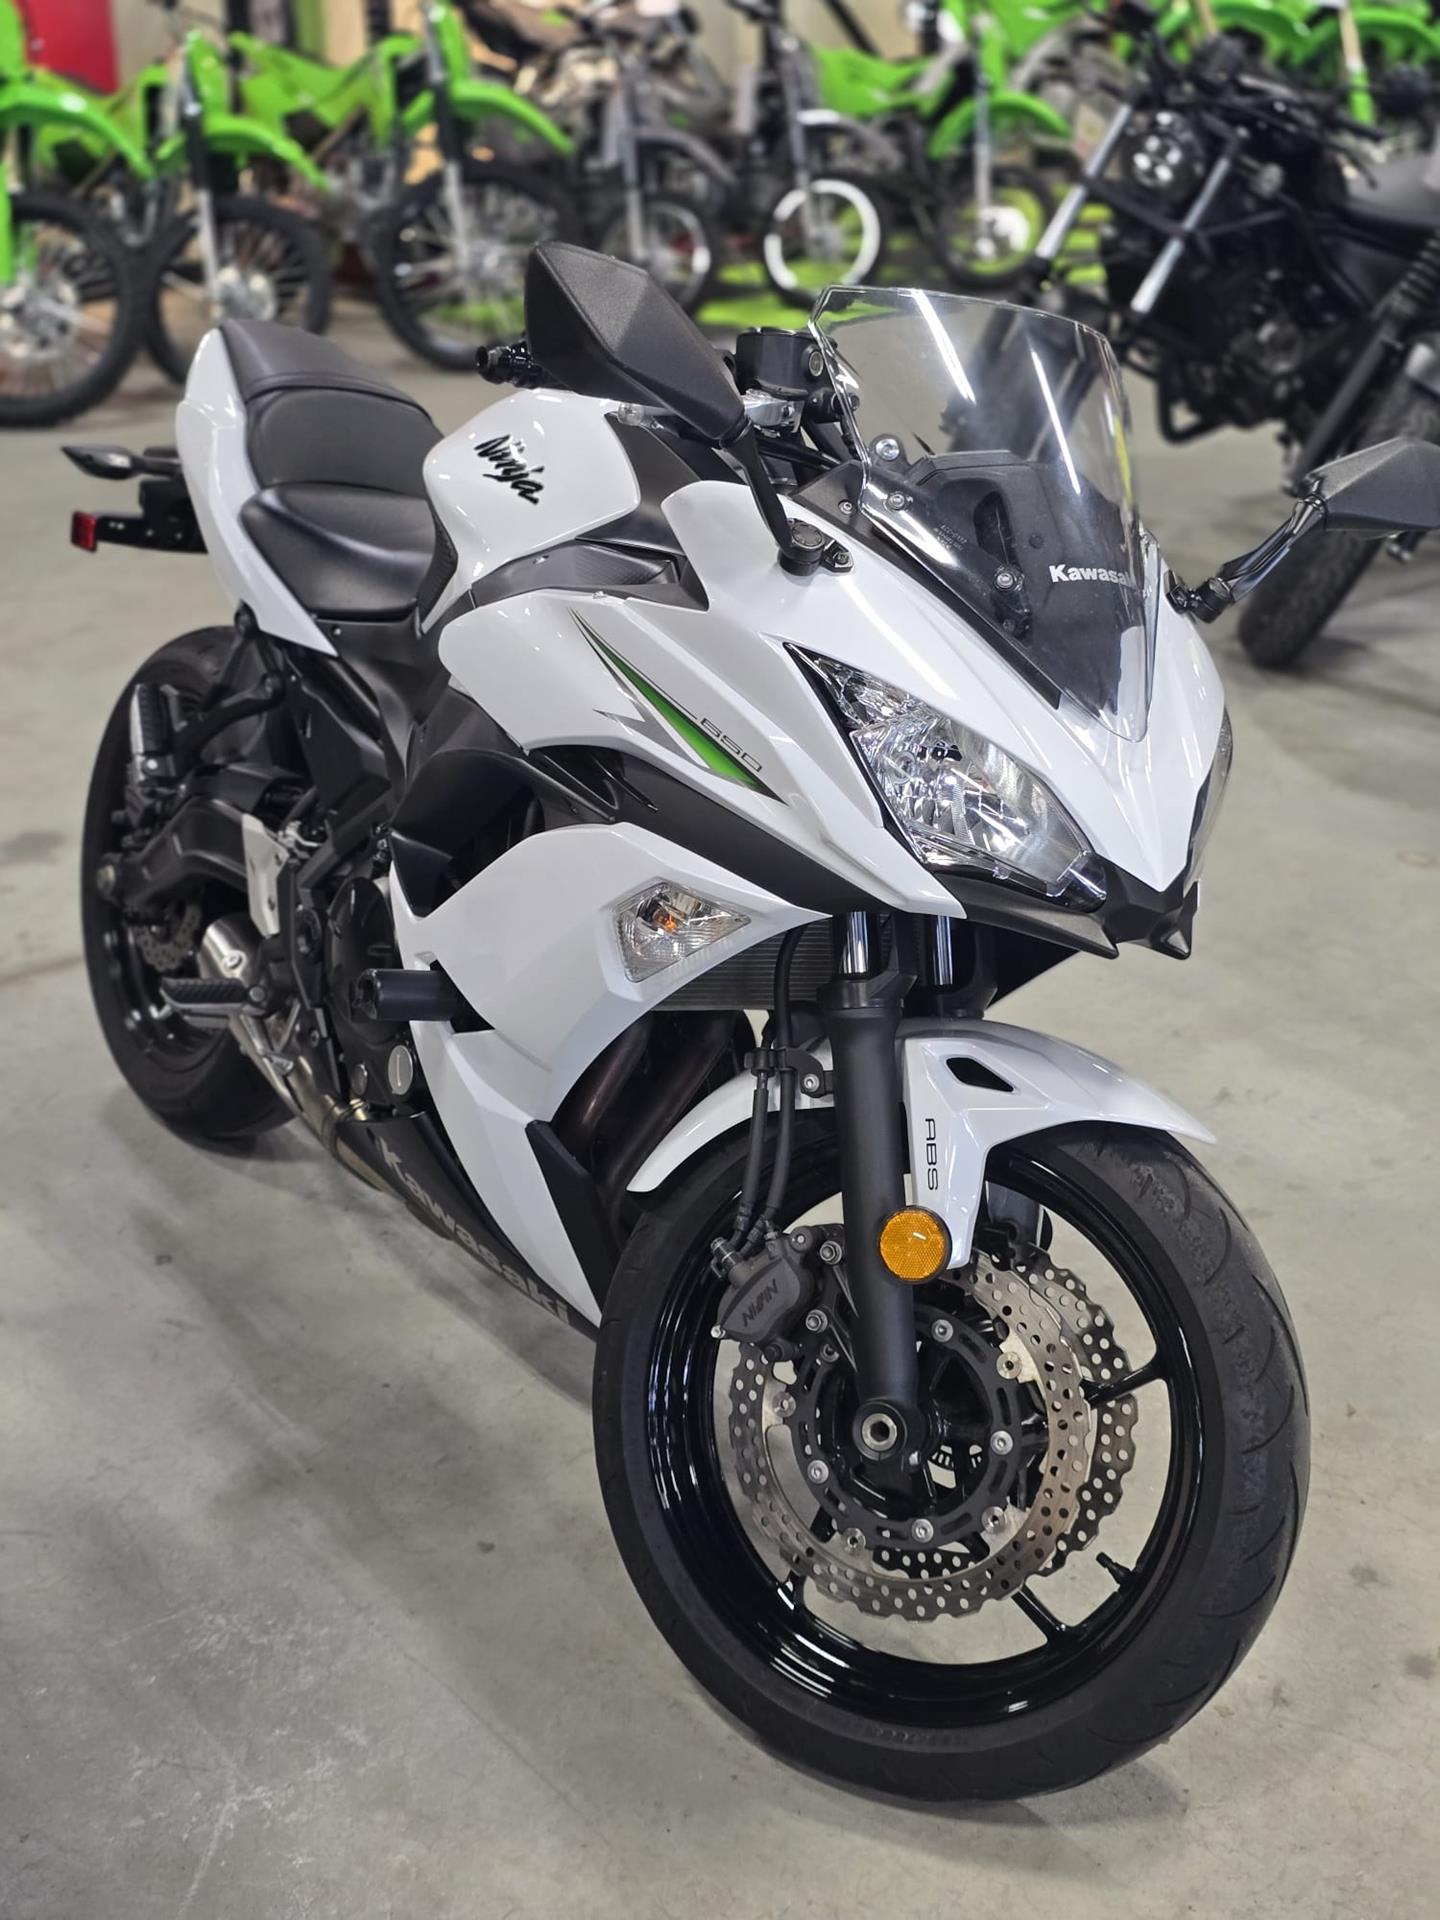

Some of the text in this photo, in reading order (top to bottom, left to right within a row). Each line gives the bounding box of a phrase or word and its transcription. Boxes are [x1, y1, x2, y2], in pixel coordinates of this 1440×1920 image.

[474, 434, 545, 506] Ninja
[701, 718, 762, 773] 650
[925, 1118, 938, 1190] ABS
[378, 1136, 570, 1325] Kawasaki
